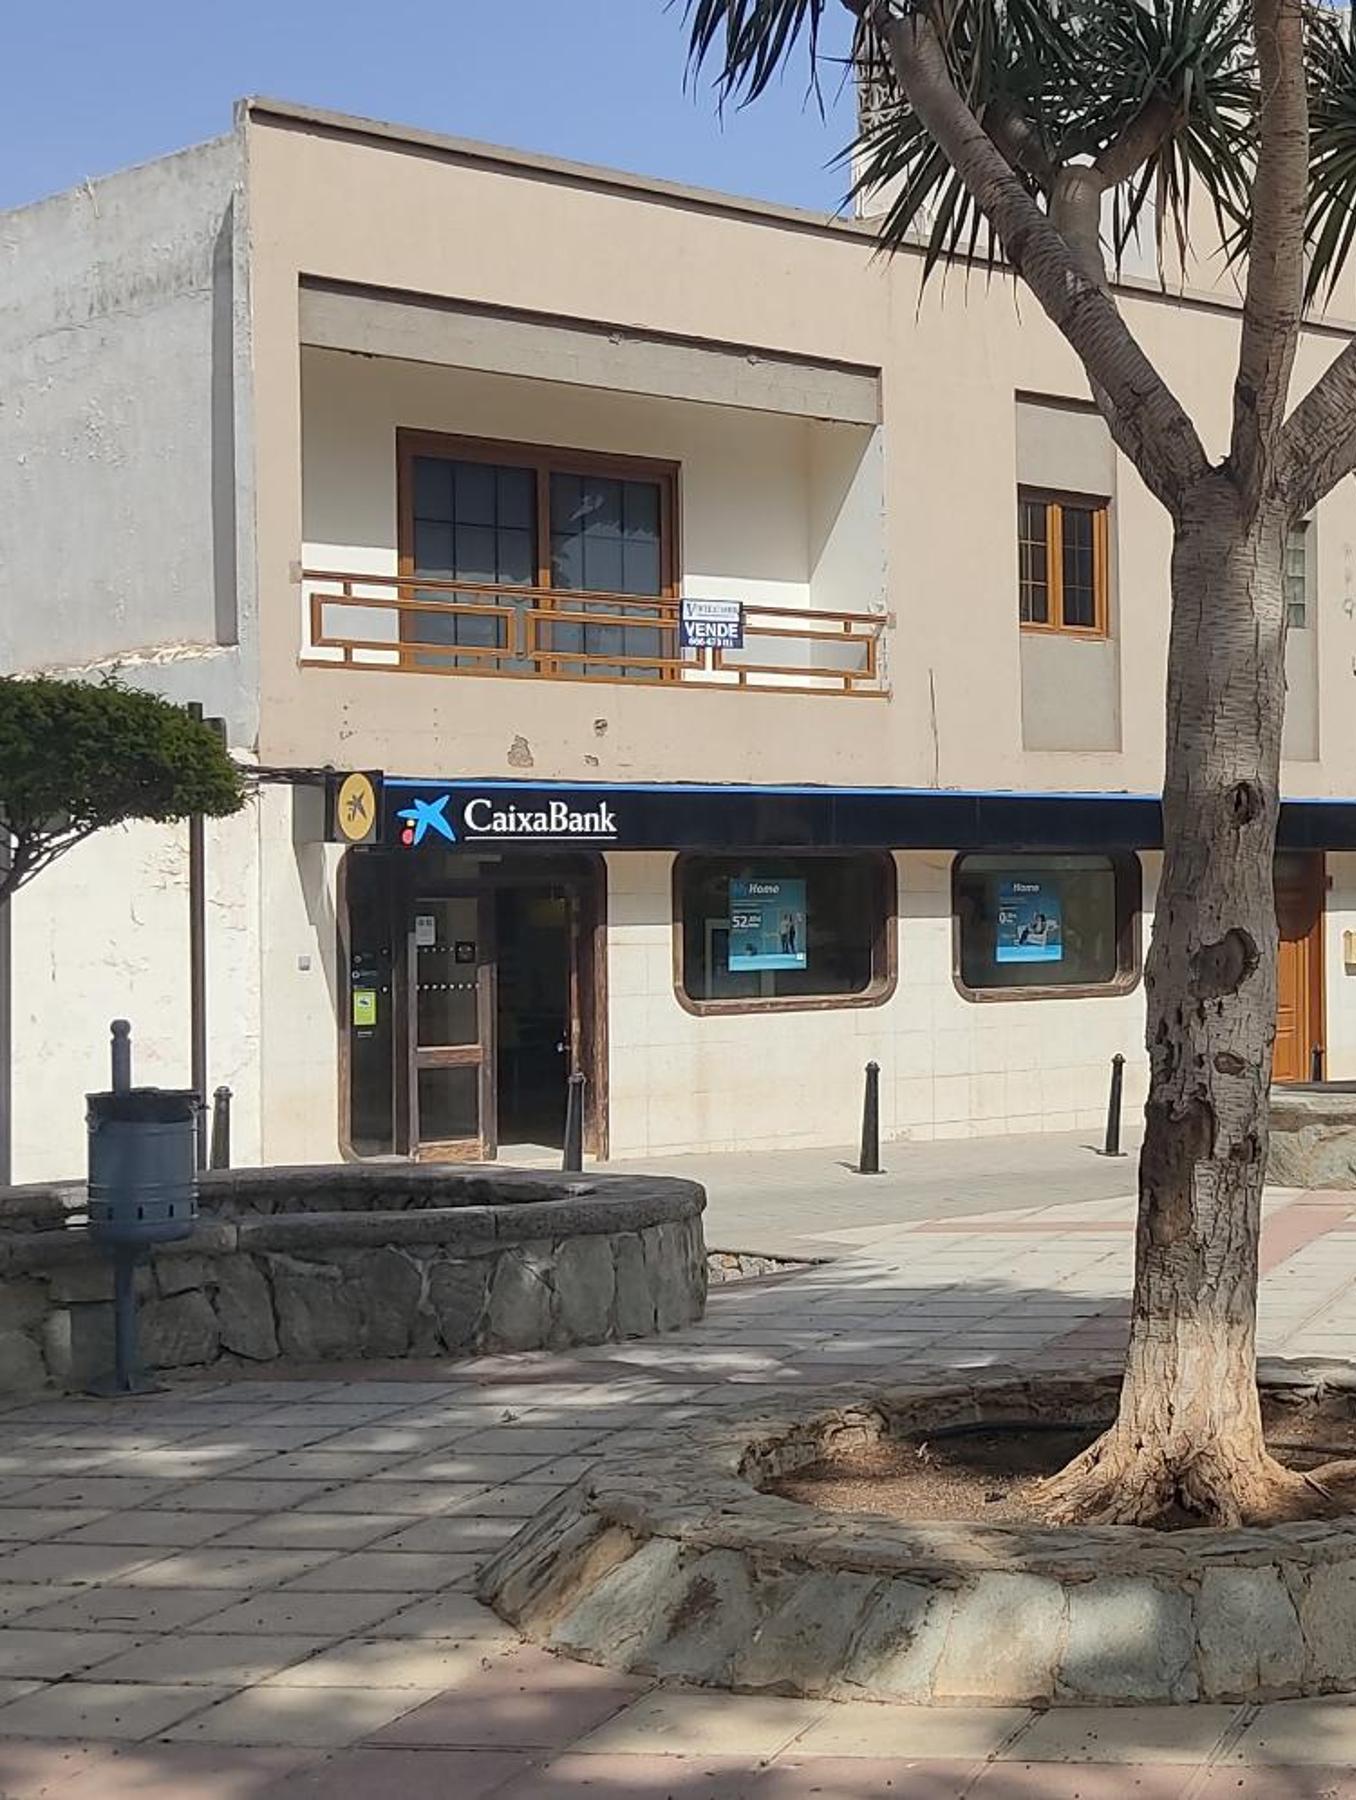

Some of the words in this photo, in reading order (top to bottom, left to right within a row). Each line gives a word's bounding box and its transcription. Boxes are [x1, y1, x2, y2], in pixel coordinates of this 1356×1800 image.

[684, 622, 739, 638] VENDE
[463, 798, 617, 832] CaixaBank
[748, 883, 780, 894] Home
